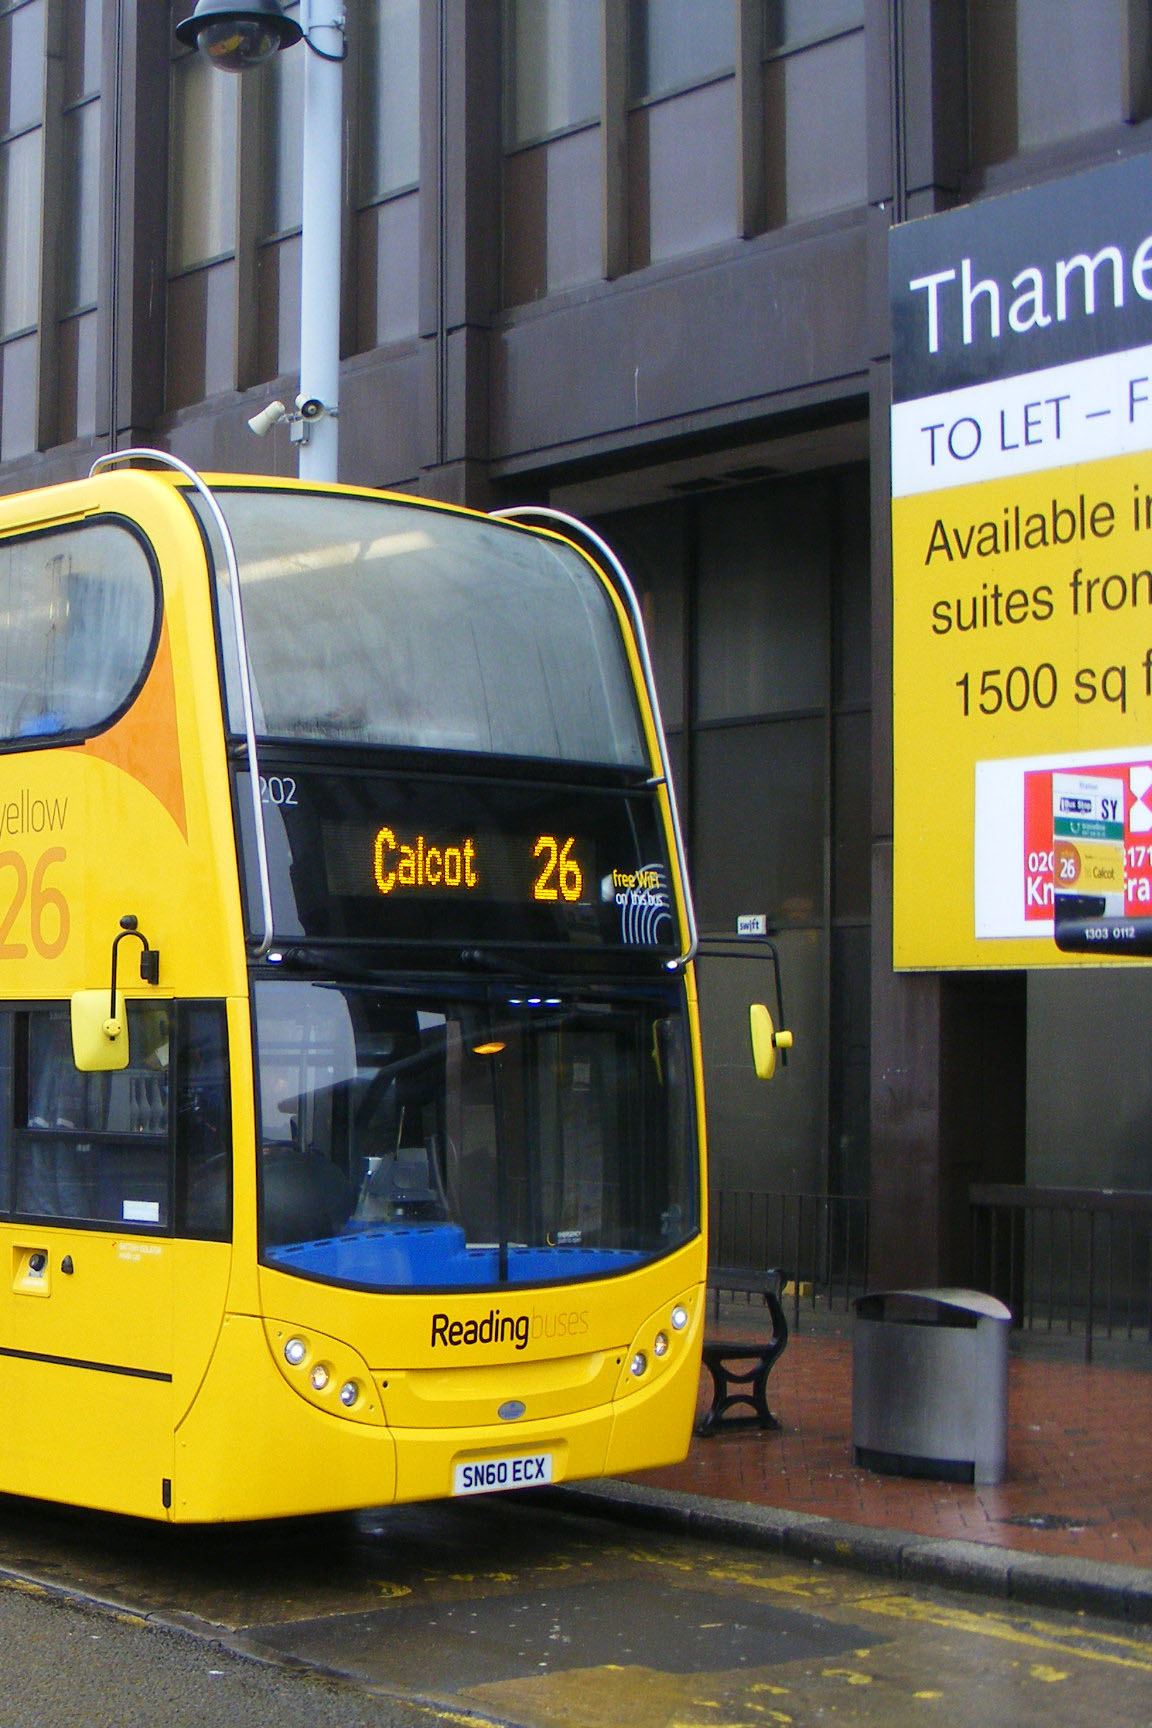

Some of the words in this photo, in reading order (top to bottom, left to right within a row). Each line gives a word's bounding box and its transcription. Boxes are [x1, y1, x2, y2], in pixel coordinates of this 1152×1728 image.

[921, 417, 981, 466] TO
[1000, 395, 1070, 451] LET
[924, 494, 1115, 565] Available
[932, 583, 1054, 635] suites
[955, 662, 1057, 716] 1500
[1074, 665, 1126, 714] sq
[1101, 798, 1118, 820] SY
[373, 826, 478, 894] Calcot
[533, 836, 582, 901] 26
[1060, 858, 1075, 879] 26
[1093, 866, 1114, 880] Calcot
[613, 869, 635, 888] free
[636, 870, 660, 889] WiFi
[615, 893, 628, 905] on
[631, 891, 647, 905] this
[648, 893, 663, 906] bus
[739, 918, 759, 931] swift
[1085, 928, 1108, 940] 1303
[1113, 926, 1135, 939] 0112
[463, 1463, 507, 1488] SN60
[512, 1458, 545, 1481] ECX
